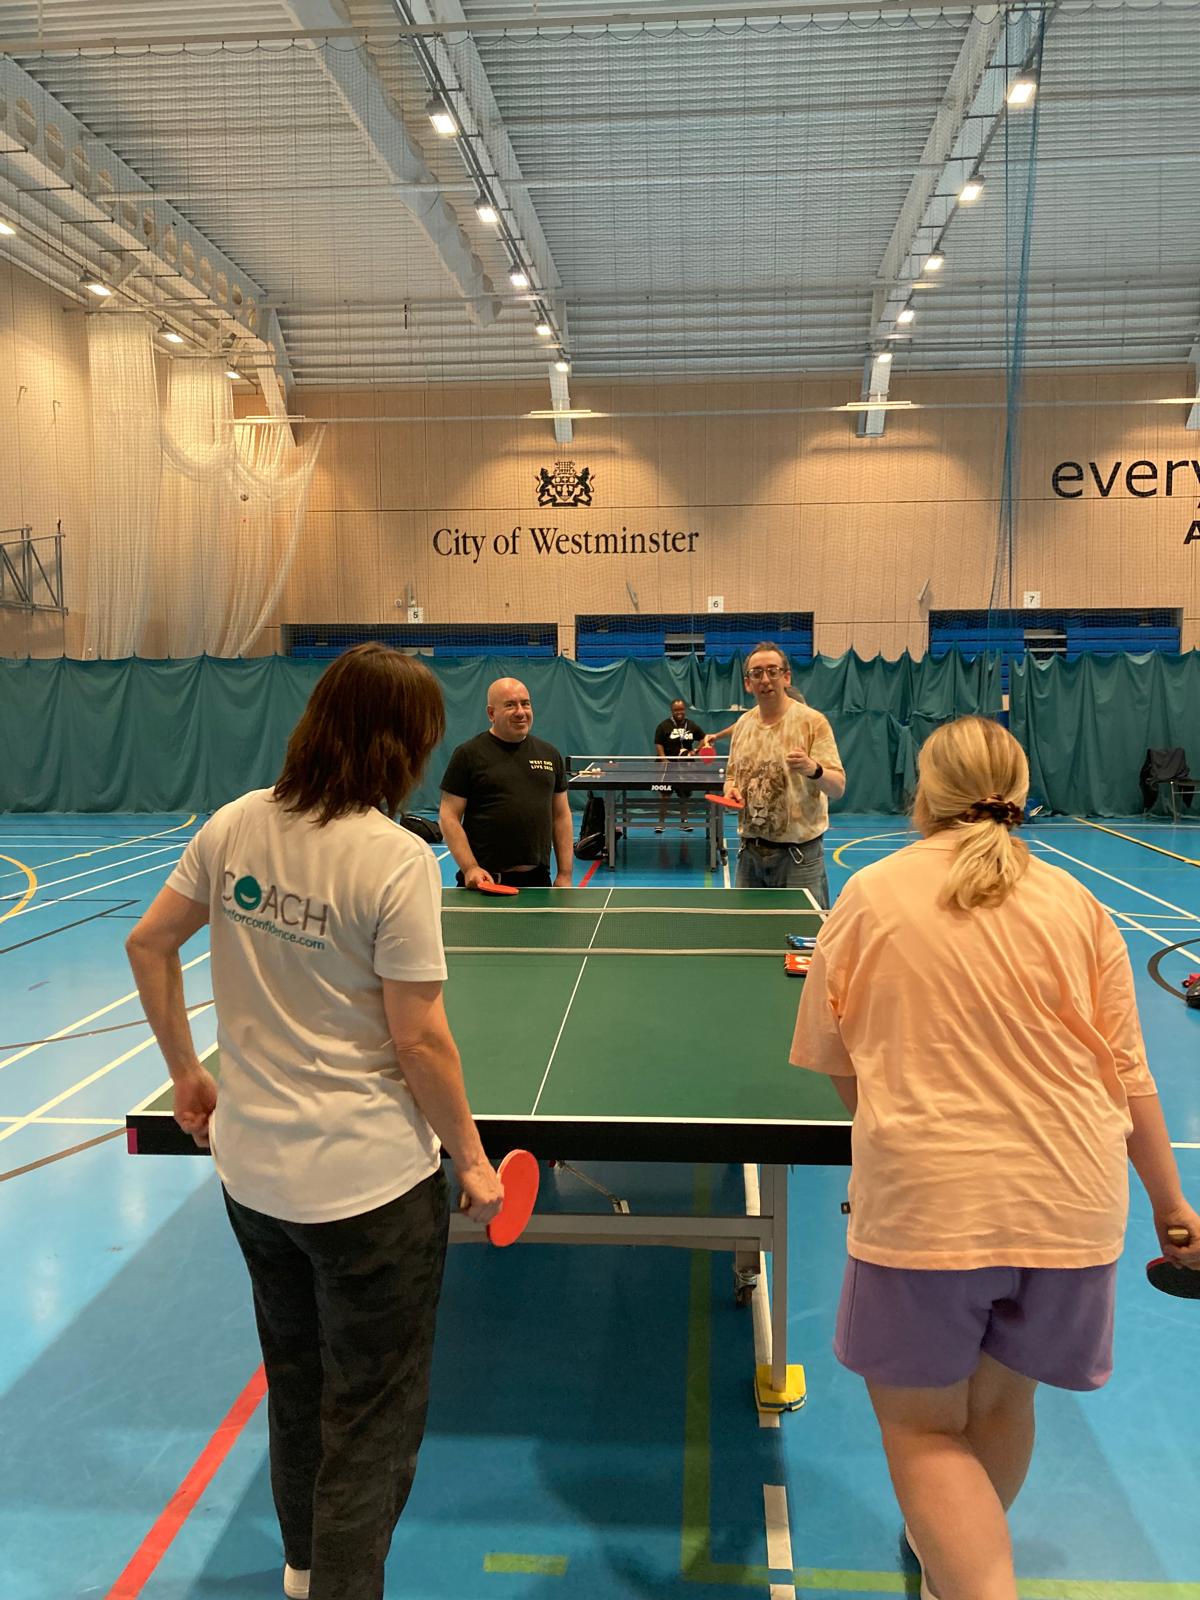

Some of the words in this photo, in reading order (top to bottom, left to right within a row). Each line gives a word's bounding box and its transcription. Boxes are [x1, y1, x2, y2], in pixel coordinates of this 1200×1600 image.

[432, 528, 486, 564] City
[493, 526, 522, 556] of
[528, 526, 699, 555] Westminster
[222, 871, 328, 936] COACH
